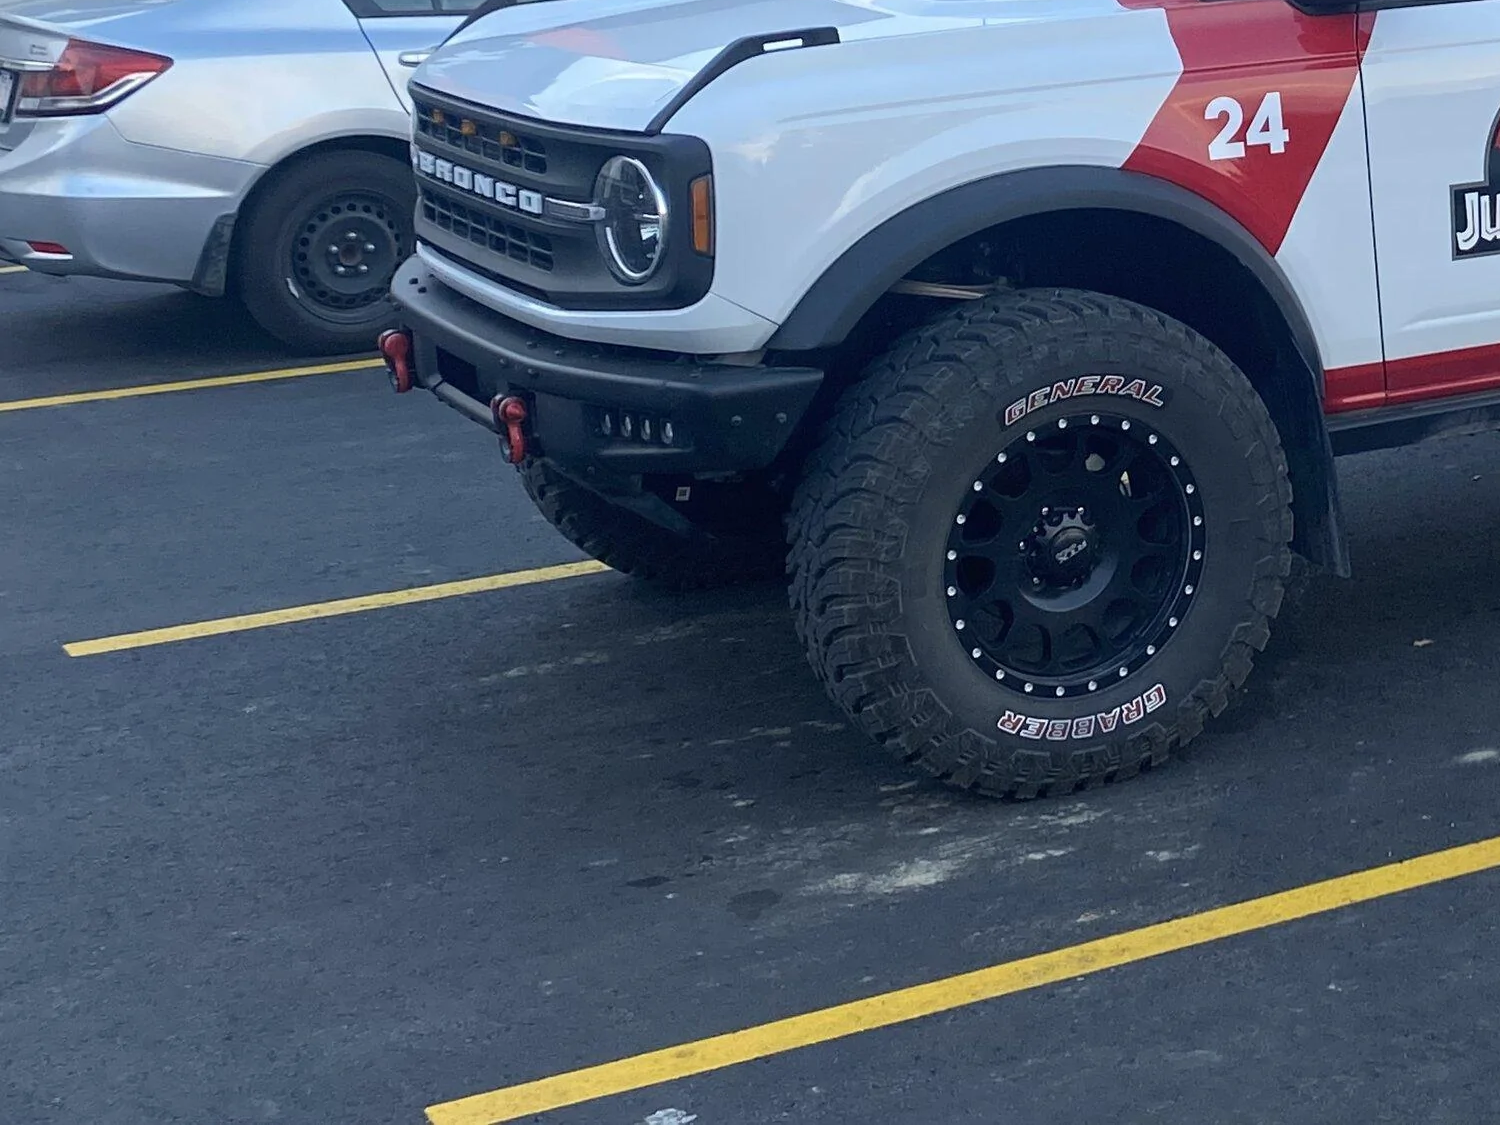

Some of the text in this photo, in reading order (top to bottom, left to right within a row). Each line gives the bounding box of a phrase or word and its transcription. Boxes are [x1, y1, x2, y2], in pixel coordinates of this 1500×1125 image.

[1203, 91, 1290, 162] 24
[418, 150, 543, 215] BRONCO
[1004, 375, 1165, 426] GENERAL
[996, 683, 1167, 740] GRABBER
